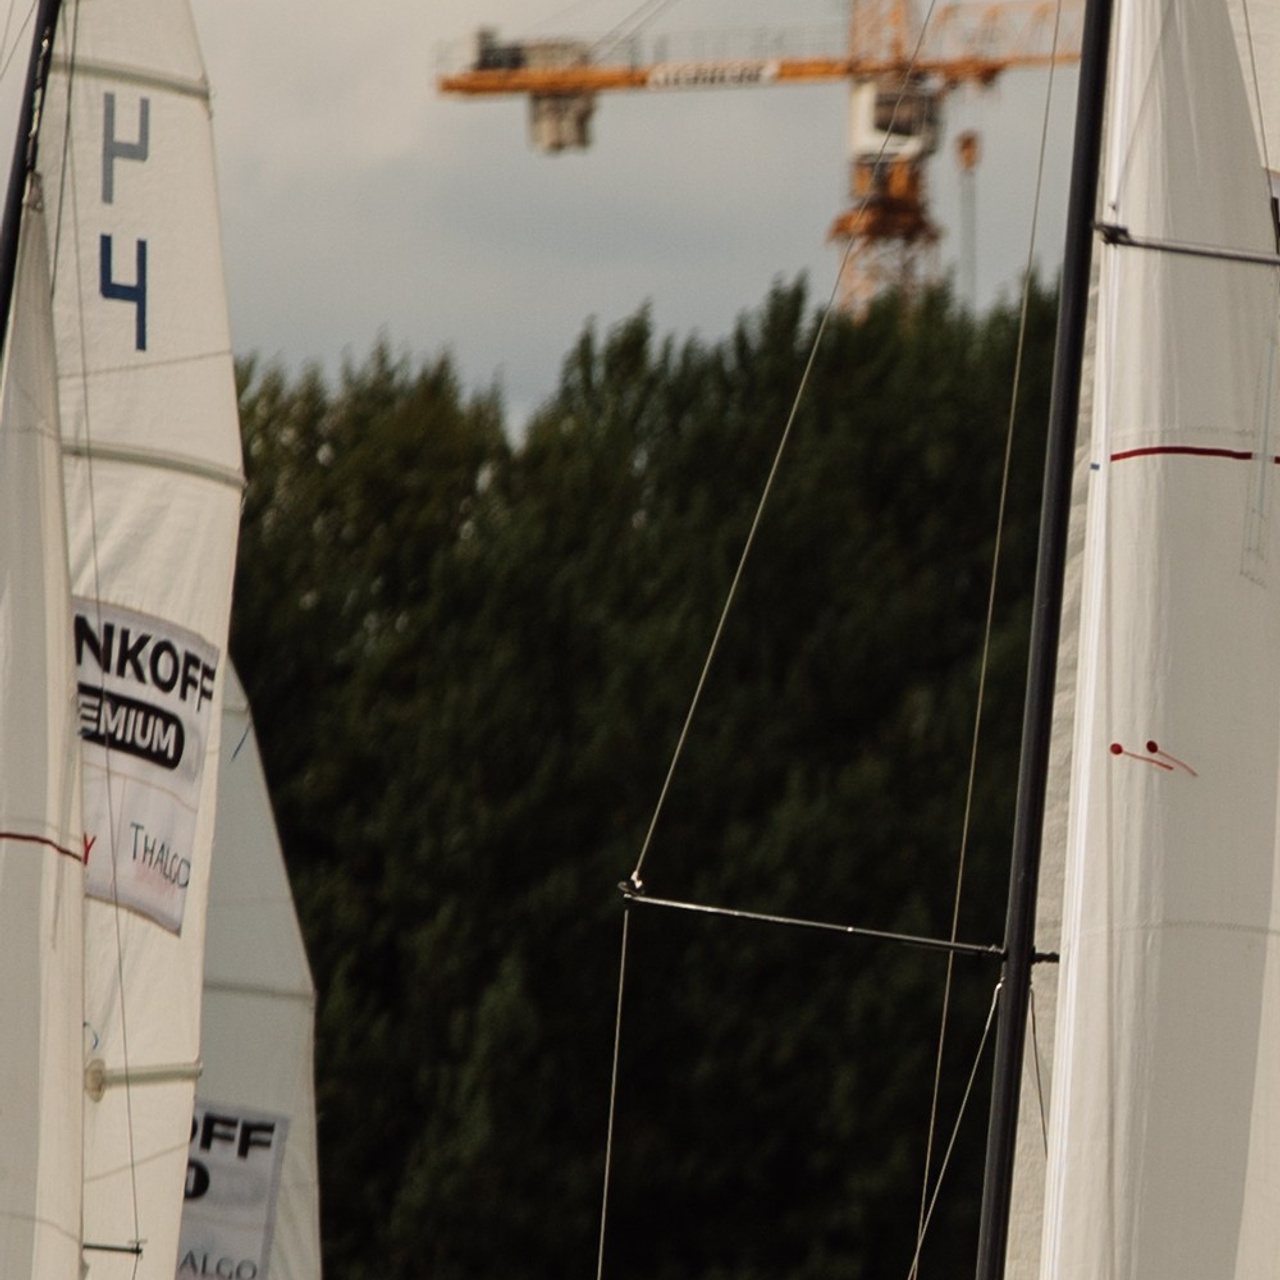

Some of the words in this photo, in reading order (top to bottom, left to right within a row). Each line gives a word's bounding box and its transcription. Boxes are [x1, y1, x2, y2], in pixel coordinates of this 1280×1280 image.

[100, 233, 147, 351] 4
[74, 614, 216, 712] NKOFF
[130, 822, 191, 889] THALGO
